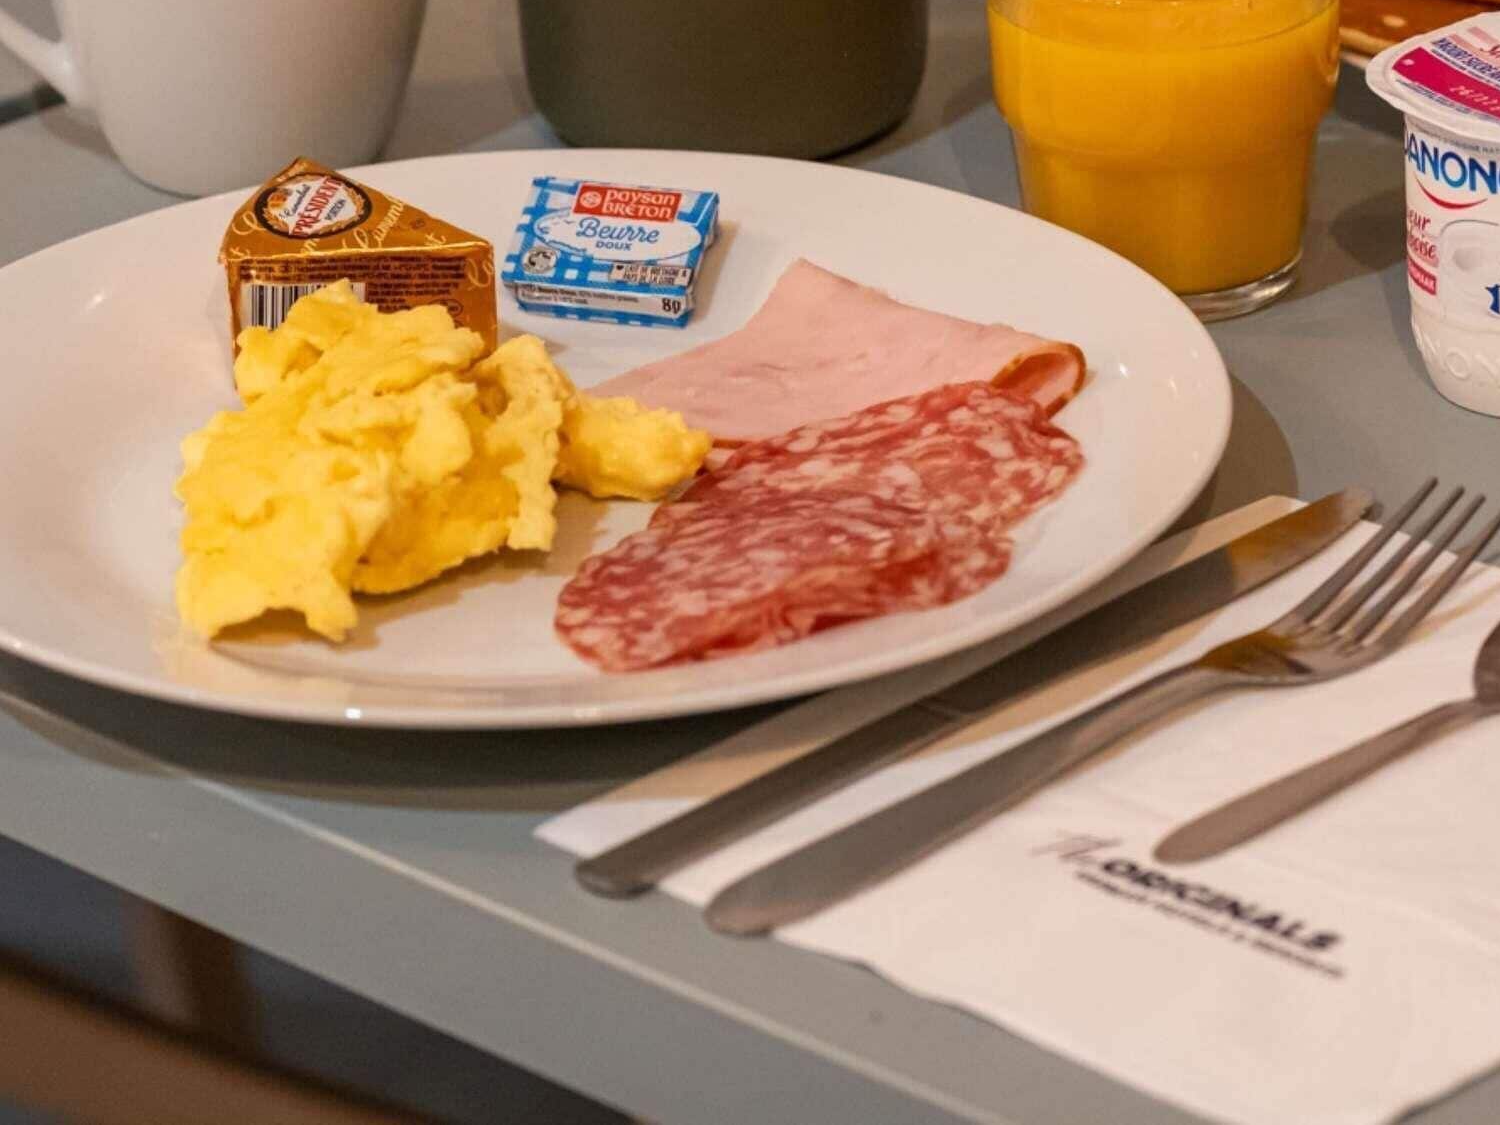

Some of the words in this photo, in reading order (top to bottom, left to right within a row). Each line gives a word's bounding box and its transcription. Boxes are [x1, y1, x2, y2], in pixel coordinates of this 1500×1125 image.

[576, 217, 660, 243] Beurre
[596, 241, 632, 251] DOUX
[1102, 858, 1341, 951] ORIGINALS
